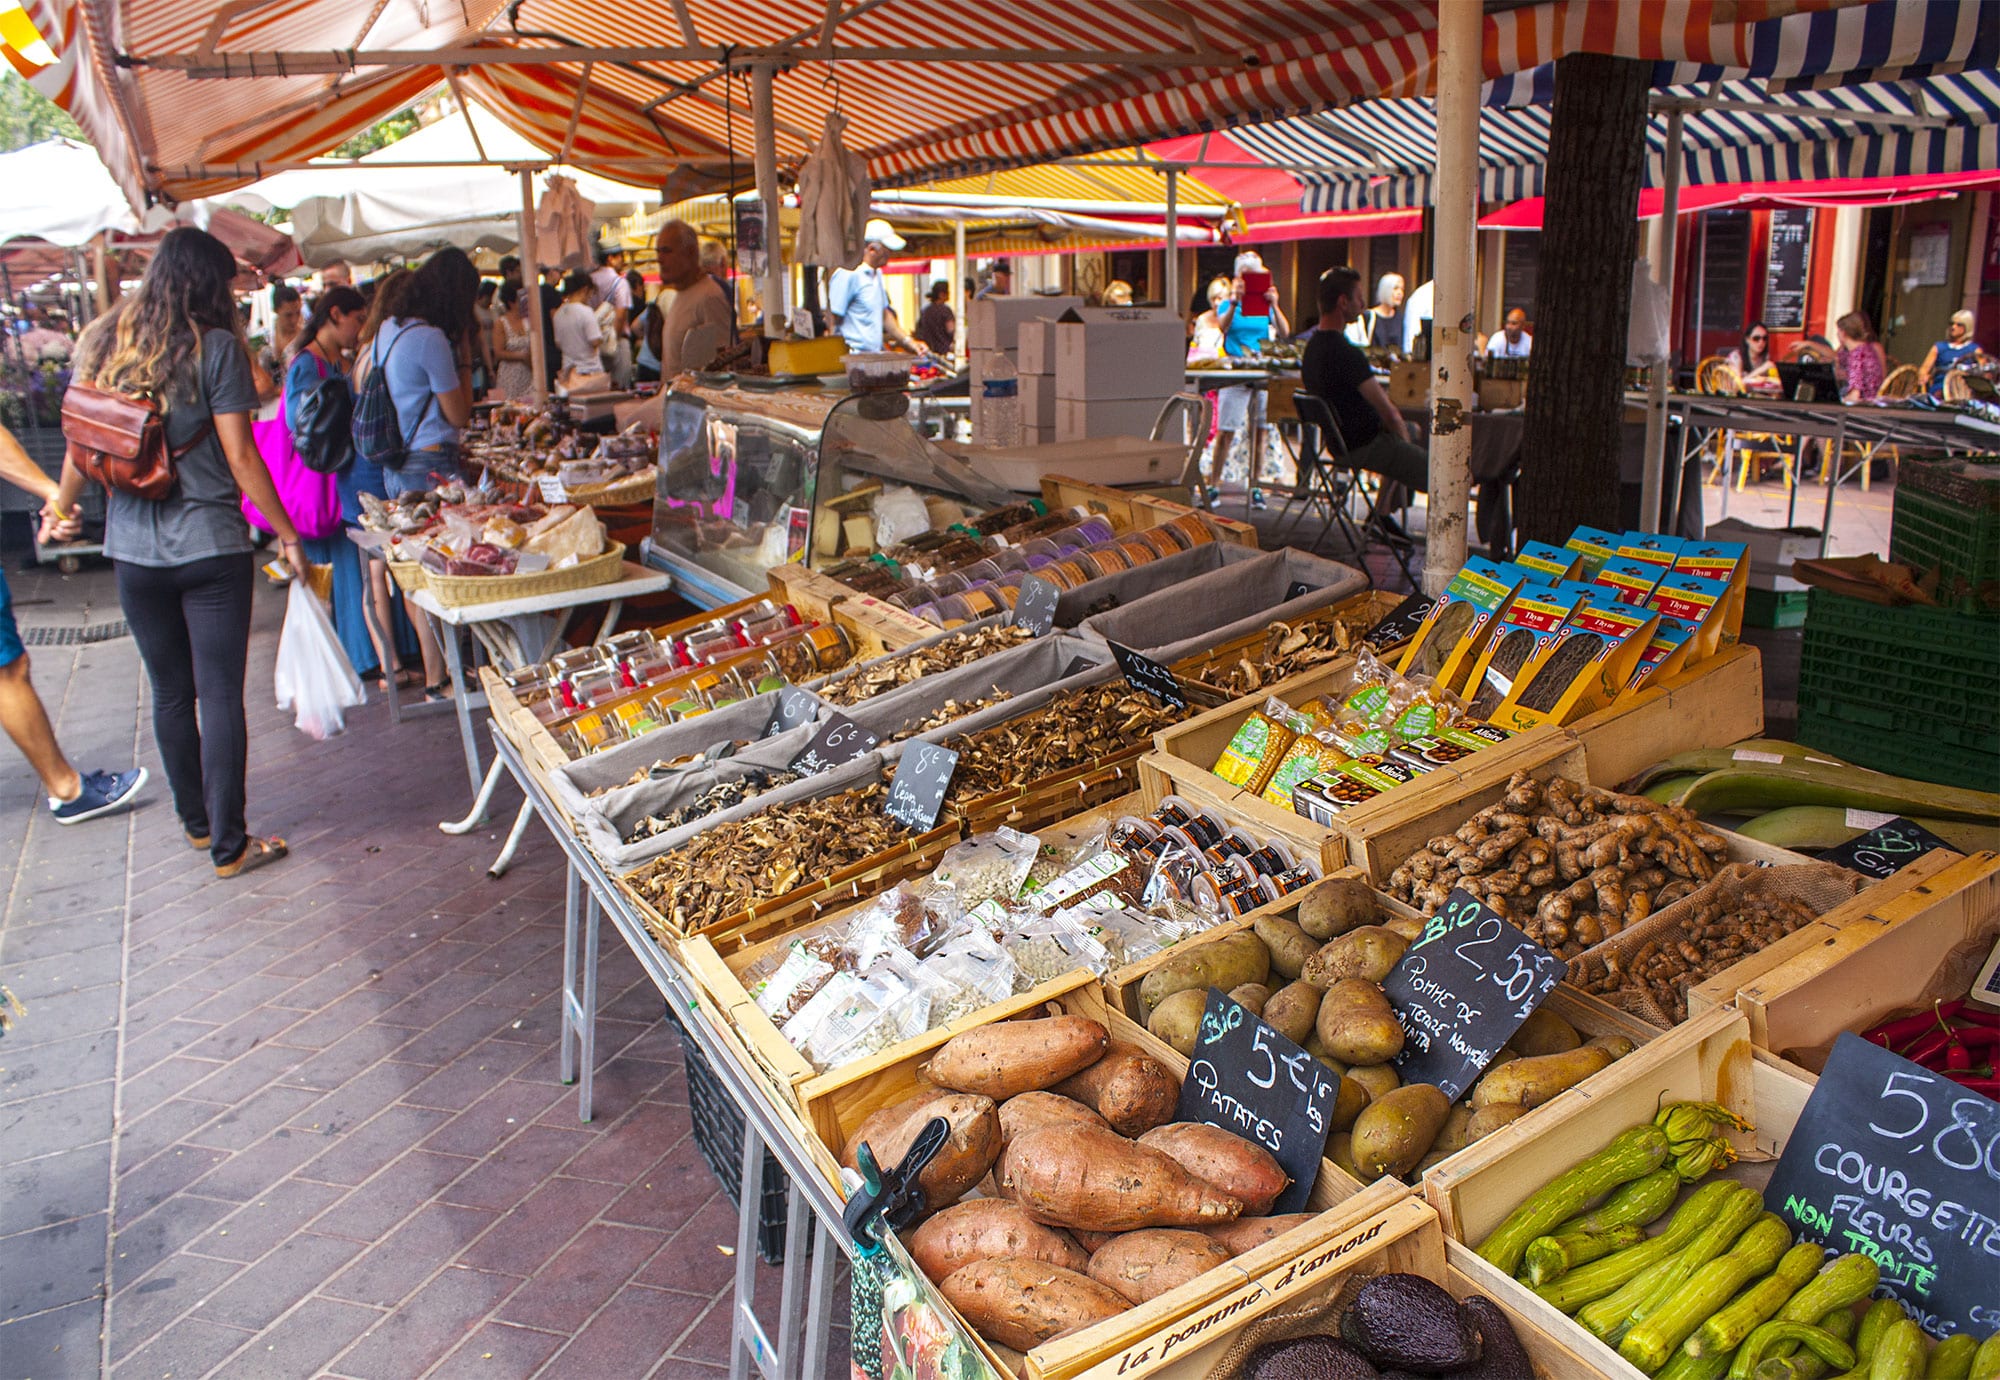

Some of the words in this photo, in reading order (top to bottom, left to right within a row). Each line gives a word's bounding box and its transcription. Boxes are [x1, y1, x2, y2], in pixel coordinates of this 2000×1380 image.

[1525, 611, 1544, 622] Thym
[1669, 600, 1690, 611] Thym
[1594, 619, 1615, 630] Thym
[1408, 1001, 1451, 1038] TERRE
[1456, 1001, 1483, 1026] DE
[1192, 1058, 1284, 1152] PATATES
[1784, 1193, 1834, 1237] NON
[1830, 1193, 1934, 1264] FLEURS
[1116, 1346, 1154, 1377] la
[1159, 1287, 1263, 1361] pomme
[1273, 1219, 1388, 1292] d'amour
